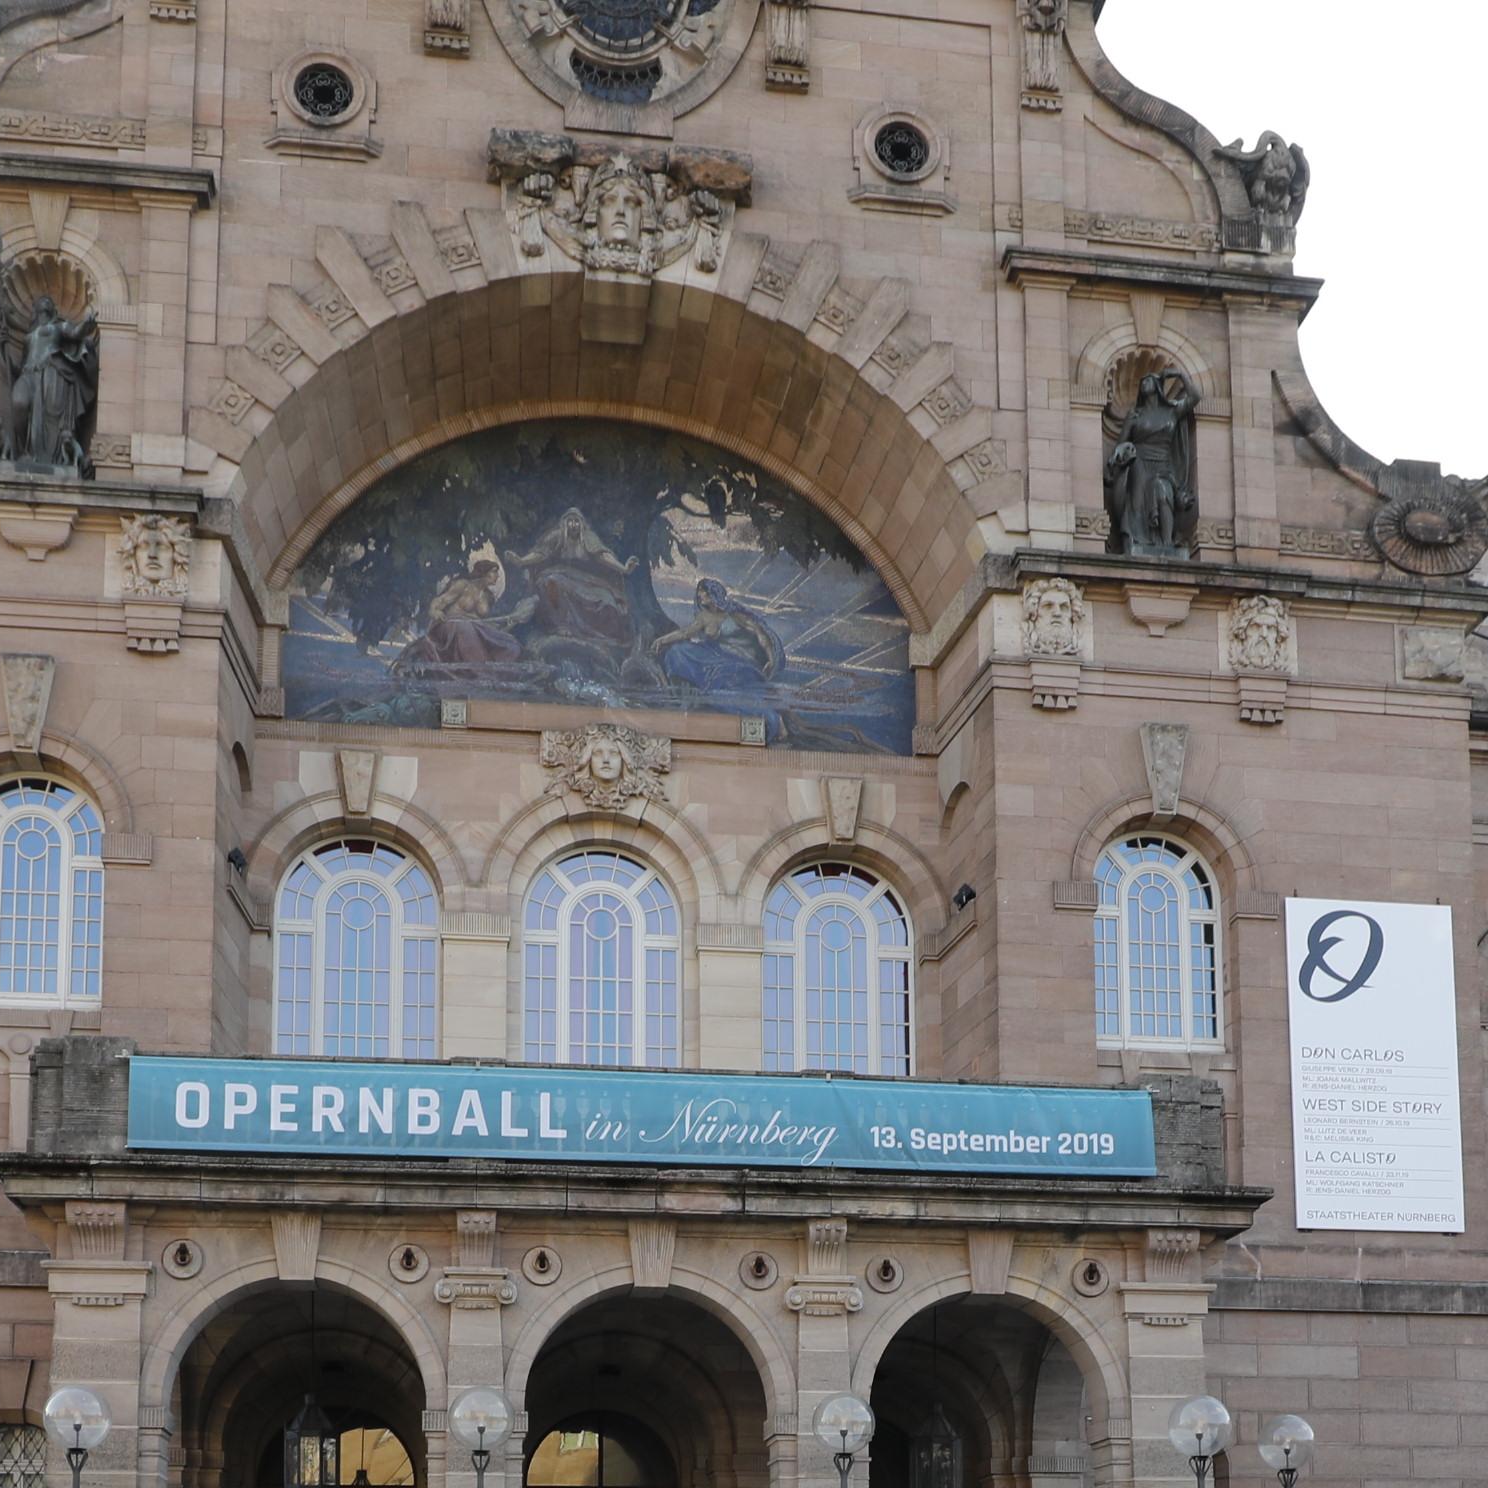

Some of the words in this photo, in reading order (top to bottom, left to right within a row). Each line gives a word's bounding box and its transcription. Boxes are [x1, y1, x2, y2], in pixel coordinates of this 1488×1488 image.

[1301, 1046, 1336, 1059] DON
[1340, 1047, 1405, 1062] CARLOS
[1302, 1098, 1347, 1112] WEST
[1351, 1099, 1387, 1113] SIDE
[1392, 1101, 1443, 1114] STORY
[175, 1081, 568, 1139] OPERNBALL
[584, 1111, 629, 1142] in
[639, 1097, 839, 1166] Nürnberg
[870, 1126, 903, 1150] 13.
[910, 1126, 1051, 1155] September
[1058, 1131, 1115, 1155] 2019
[1305, 1150, 1325, 1163] LA
[1330, 1150, 1396, 1165] CALISTO
[1306, 1210, 1394, 1221] STAATSTHEATER
